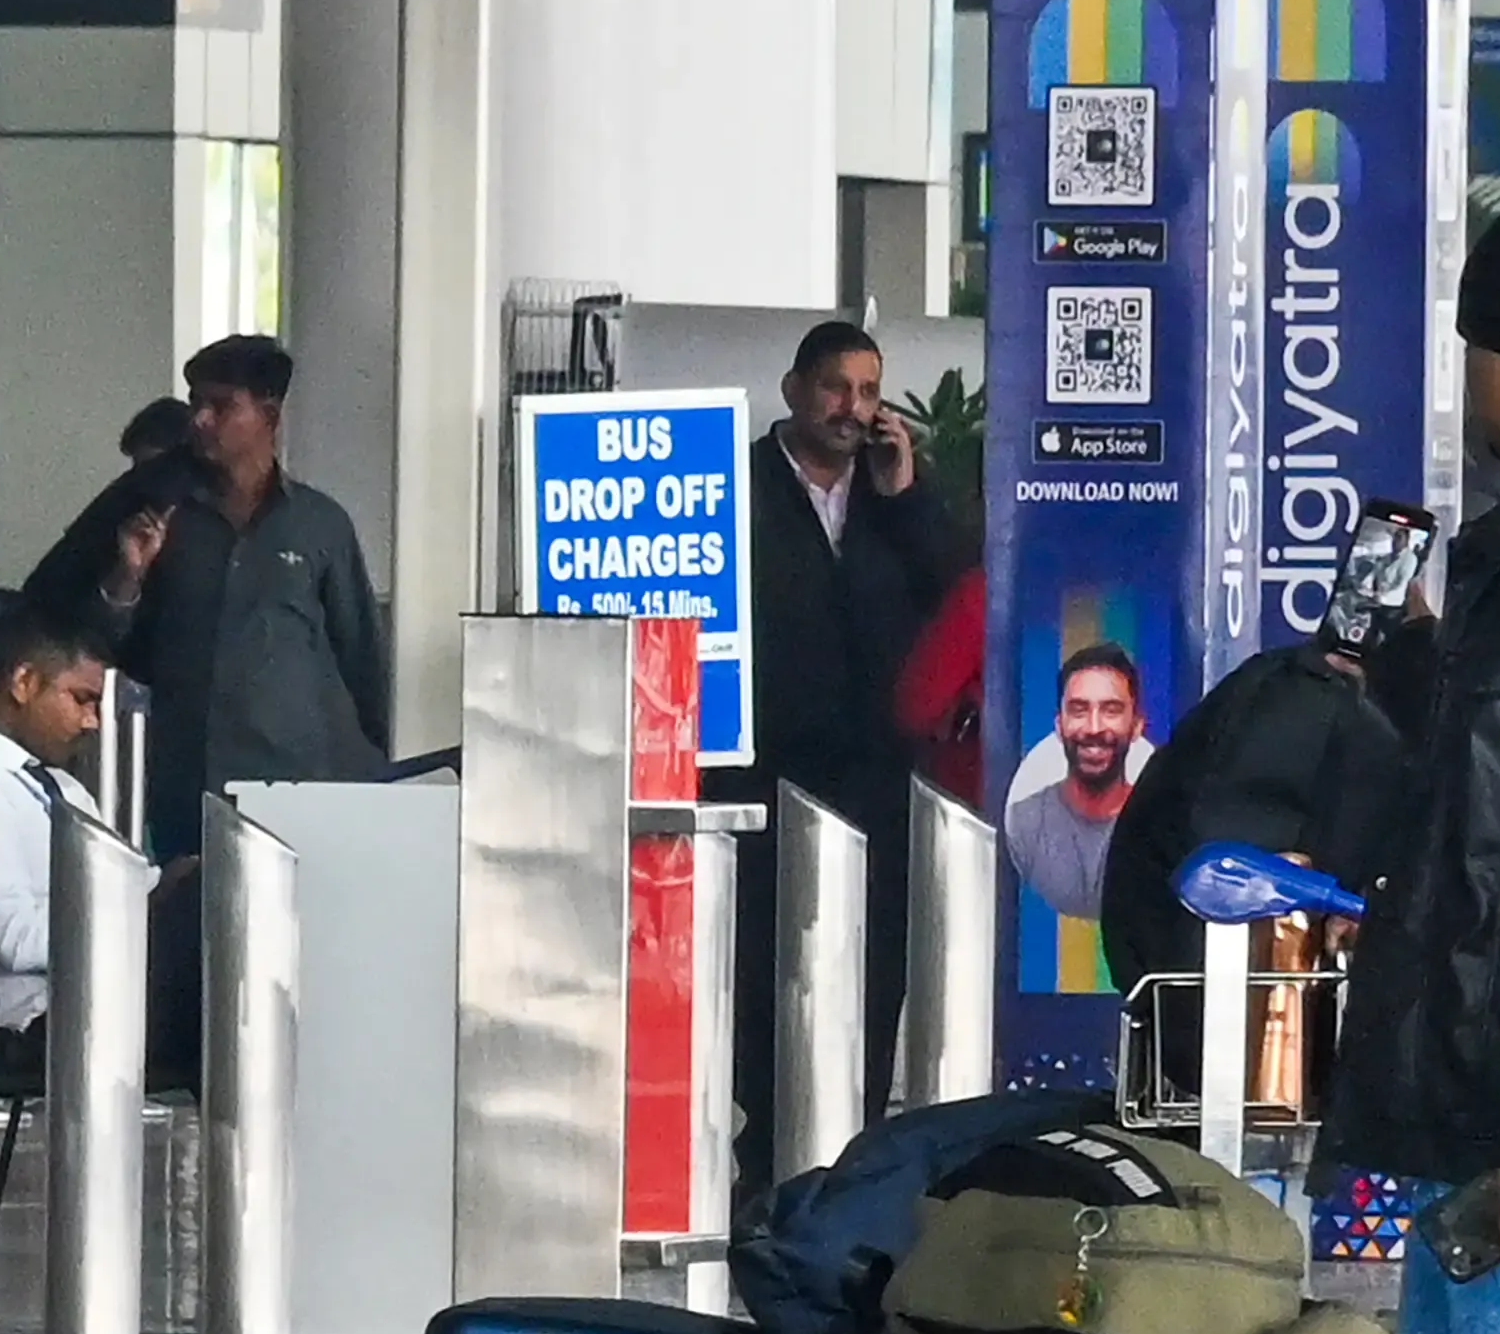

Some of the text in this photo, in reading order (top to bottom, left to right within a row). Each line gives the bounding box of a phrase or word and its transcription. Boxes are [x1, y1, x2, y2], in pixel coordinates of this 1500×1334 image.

[1073, 237, 1159, 259] Google Play
[1261, 183, 1360, 635] digiyatra
[597, 416, 672, 462] BUS
[1071, 437, 1148, 457] App Store
[545, 474, 726, 523] DROP OFF
[1016, 481, 1179, 502] DOWNLOAD NOW!
[548, 531, 726, 581] CHARGES
[641, 590, 665, 617] 15
